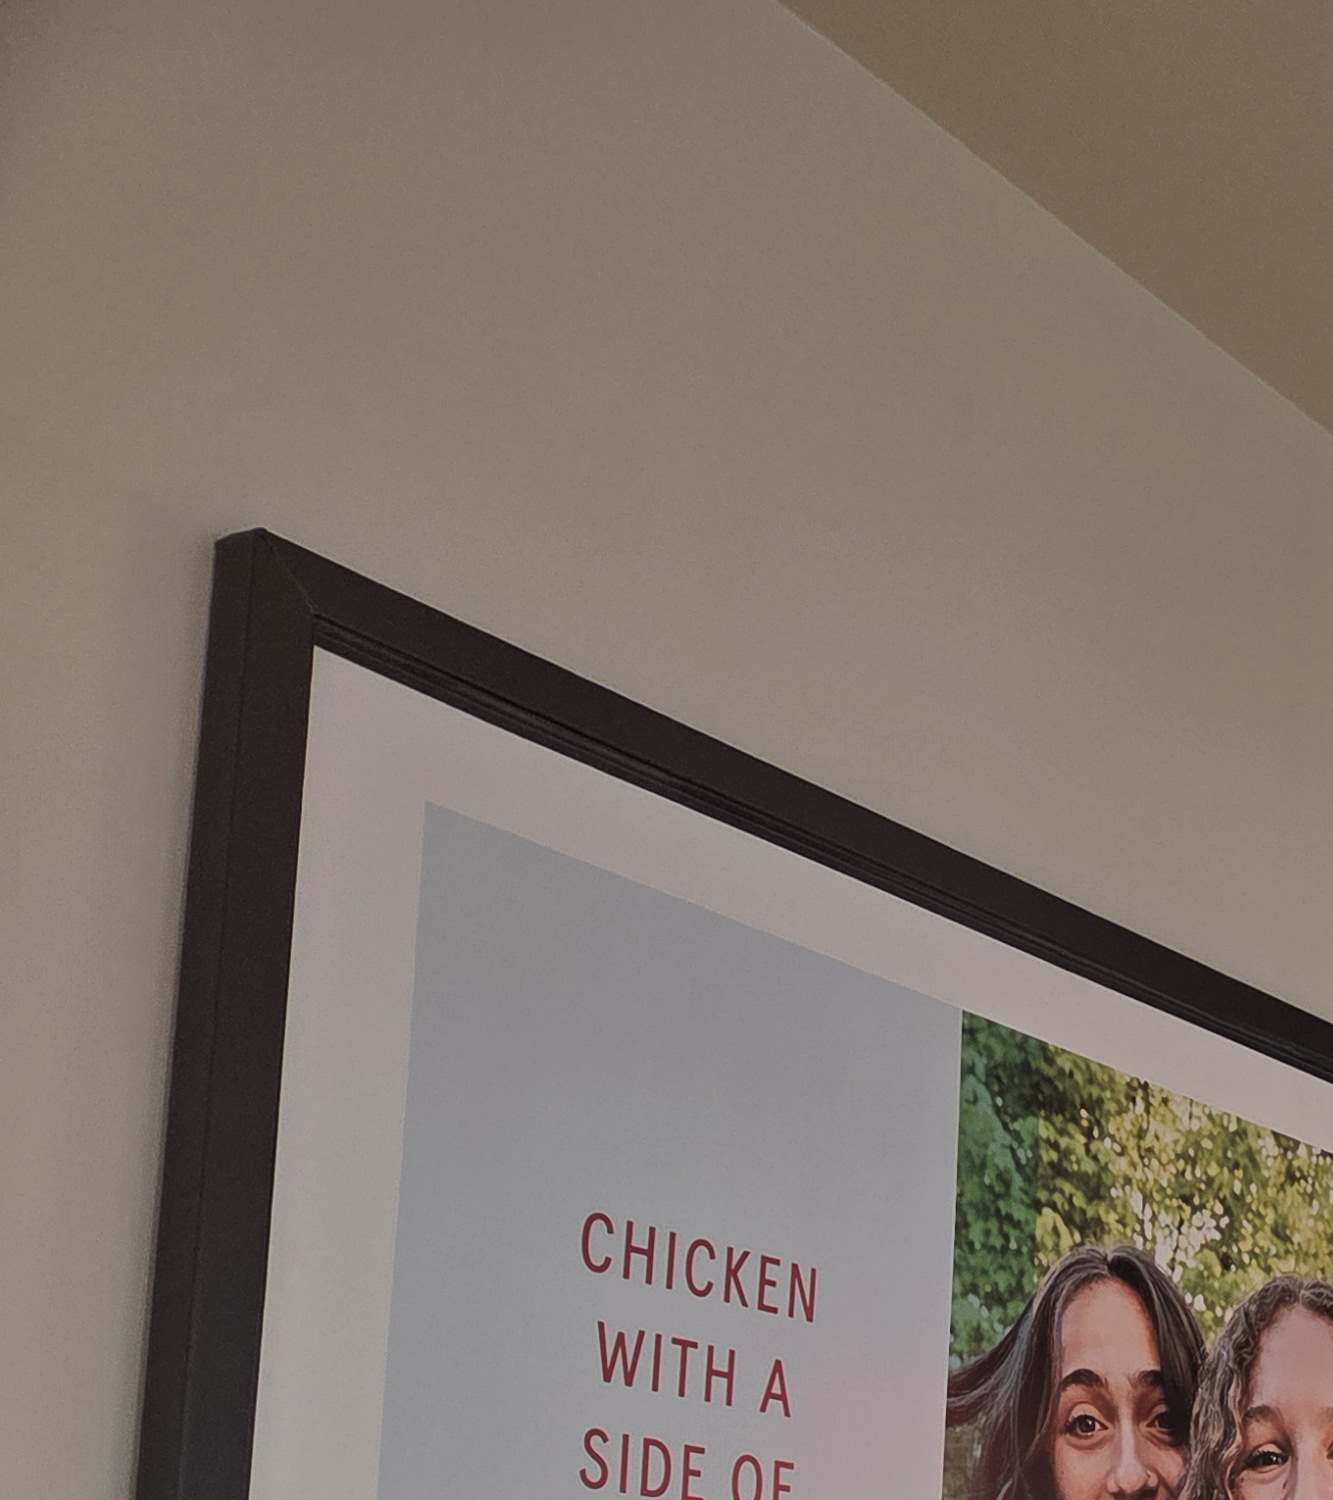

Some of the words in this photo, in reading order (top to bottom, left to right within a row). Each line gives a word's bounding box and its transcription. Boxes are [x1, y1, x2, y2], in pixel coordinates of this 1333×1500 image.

[580, 1211, 818, 1323] CHICKEN
[597, 1320, 736, 1407] WITH
[758, 1358, 792, 1418] A
